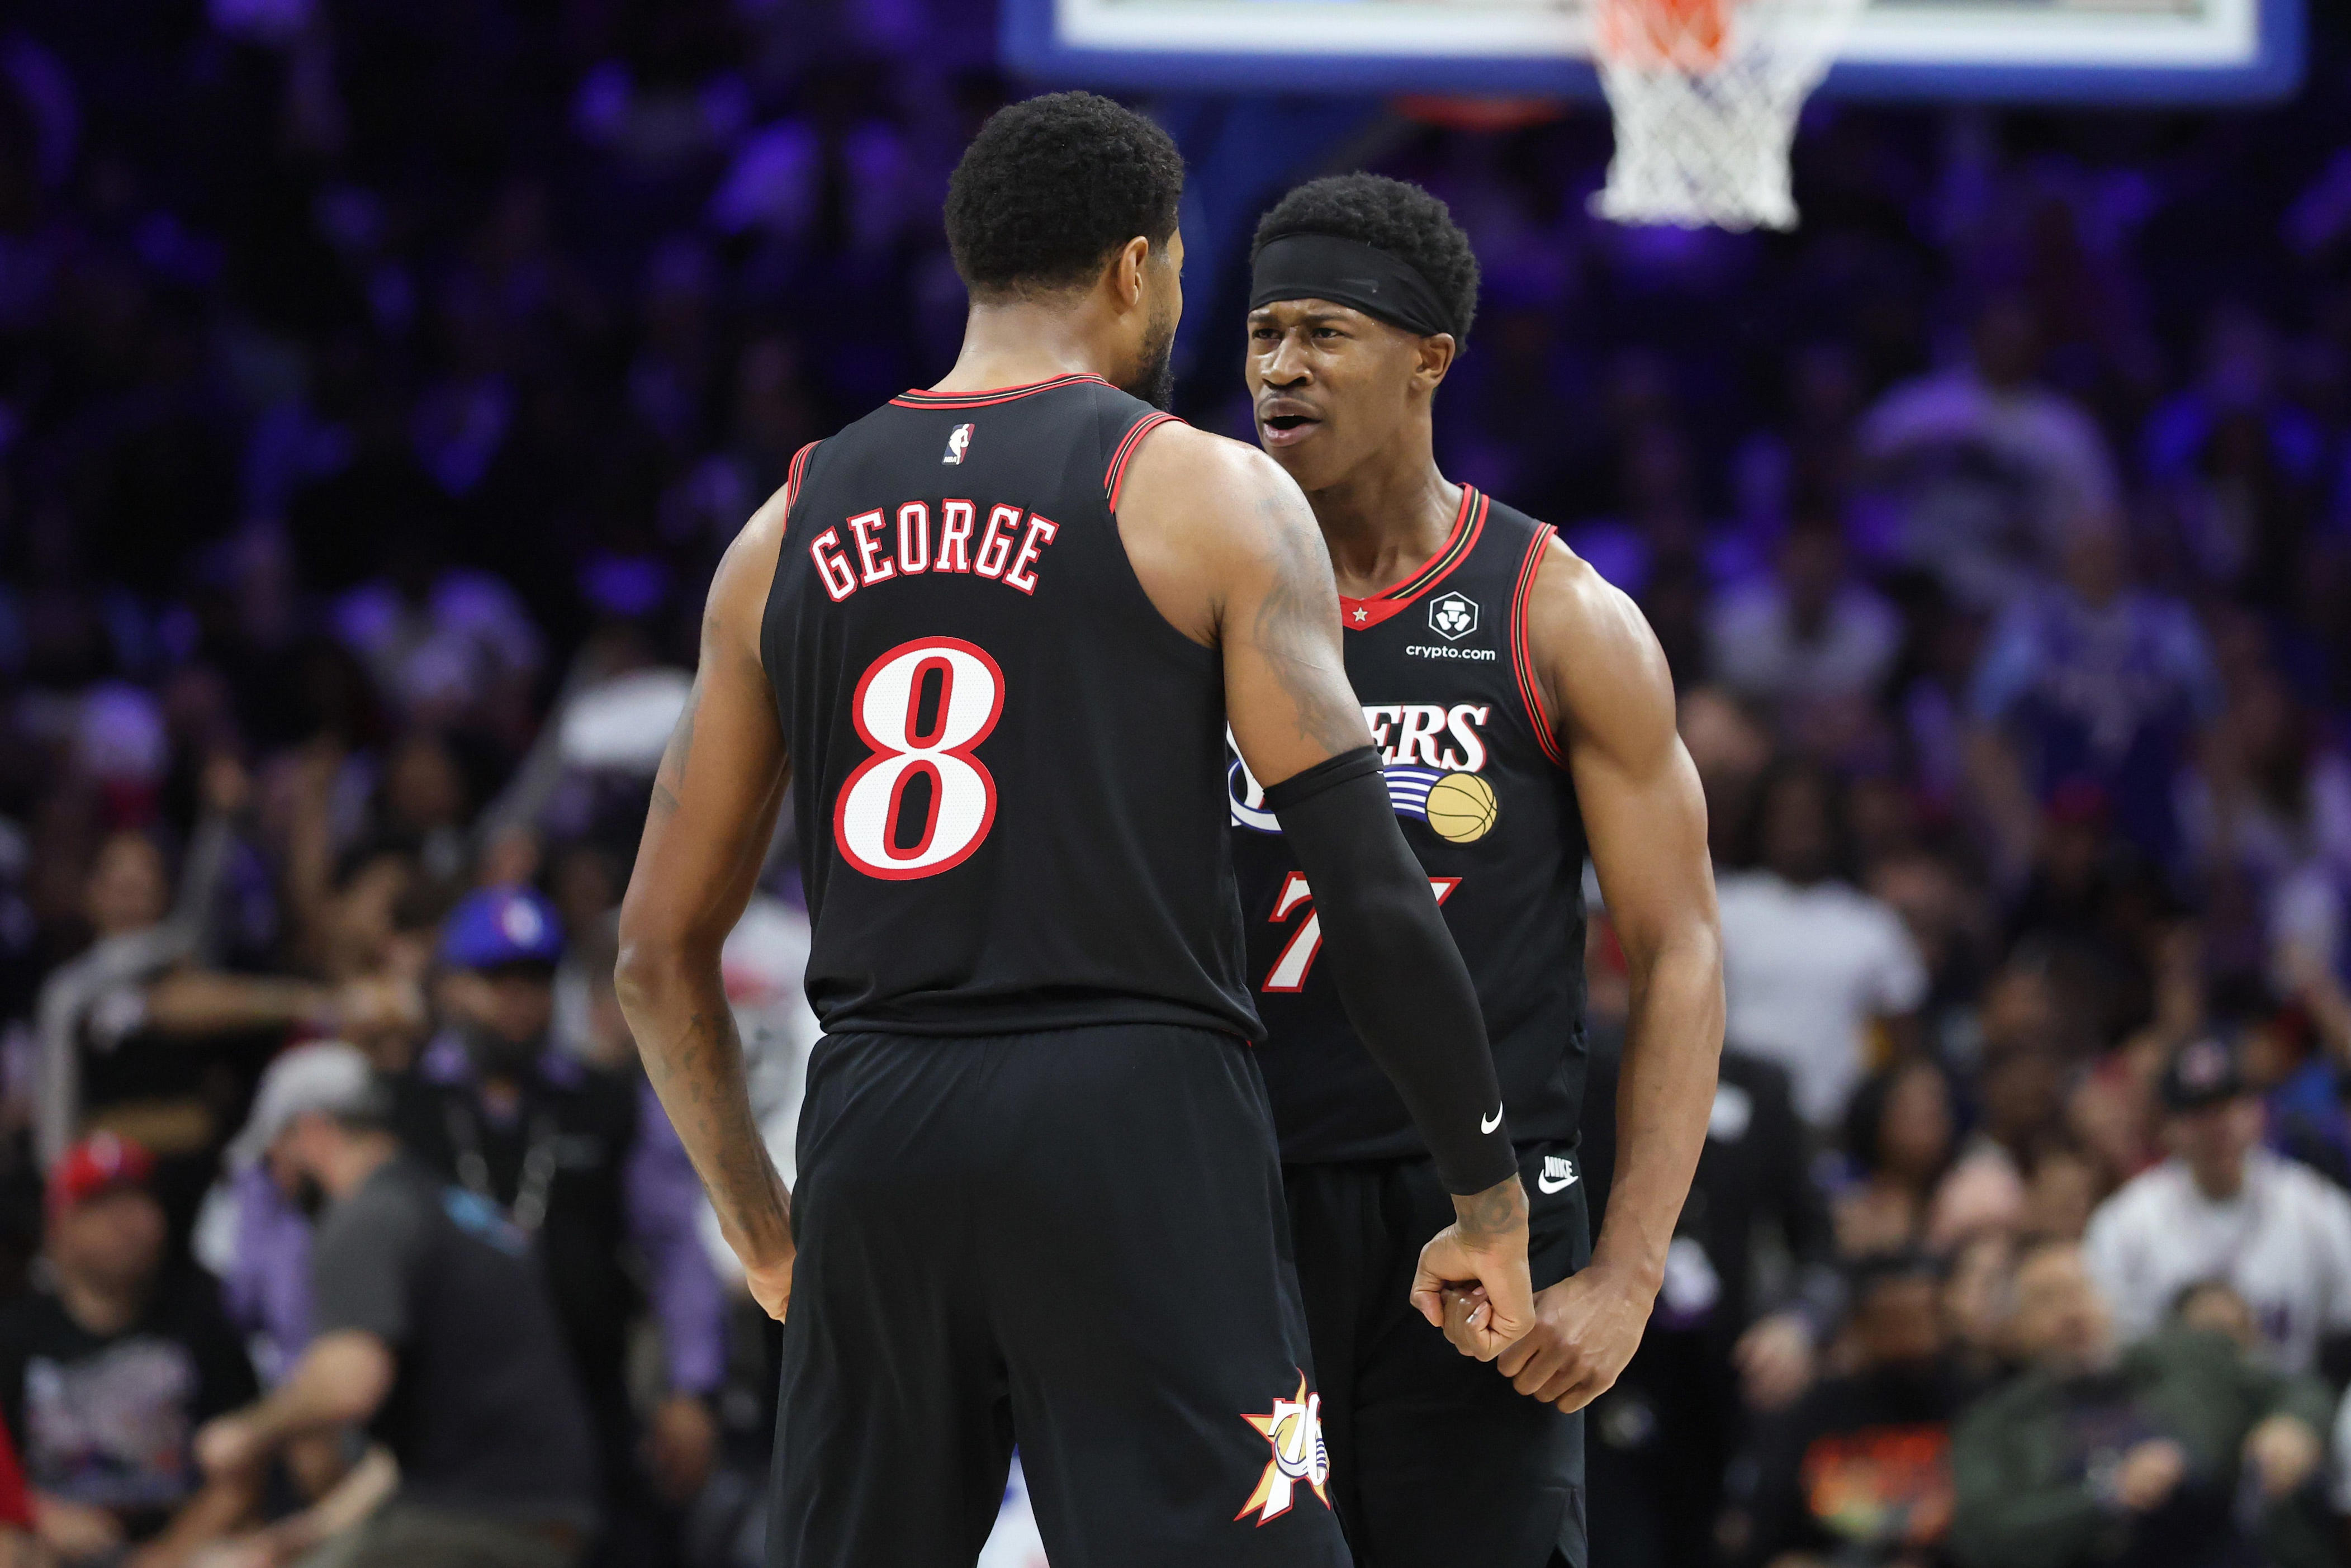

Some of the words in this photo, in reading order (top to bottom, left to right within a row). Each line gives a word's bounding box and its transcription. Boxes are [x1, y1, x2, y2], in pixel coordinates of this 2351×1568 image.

[810, 499, 1059, 602] GEORGE
[1406, 646, 1495, 660] crypto.com
[833, 636, 1005, 881] 8
[1362, 704, 1490, 773] ERS
[1544, 1155, 1572, 1178] NIKE
